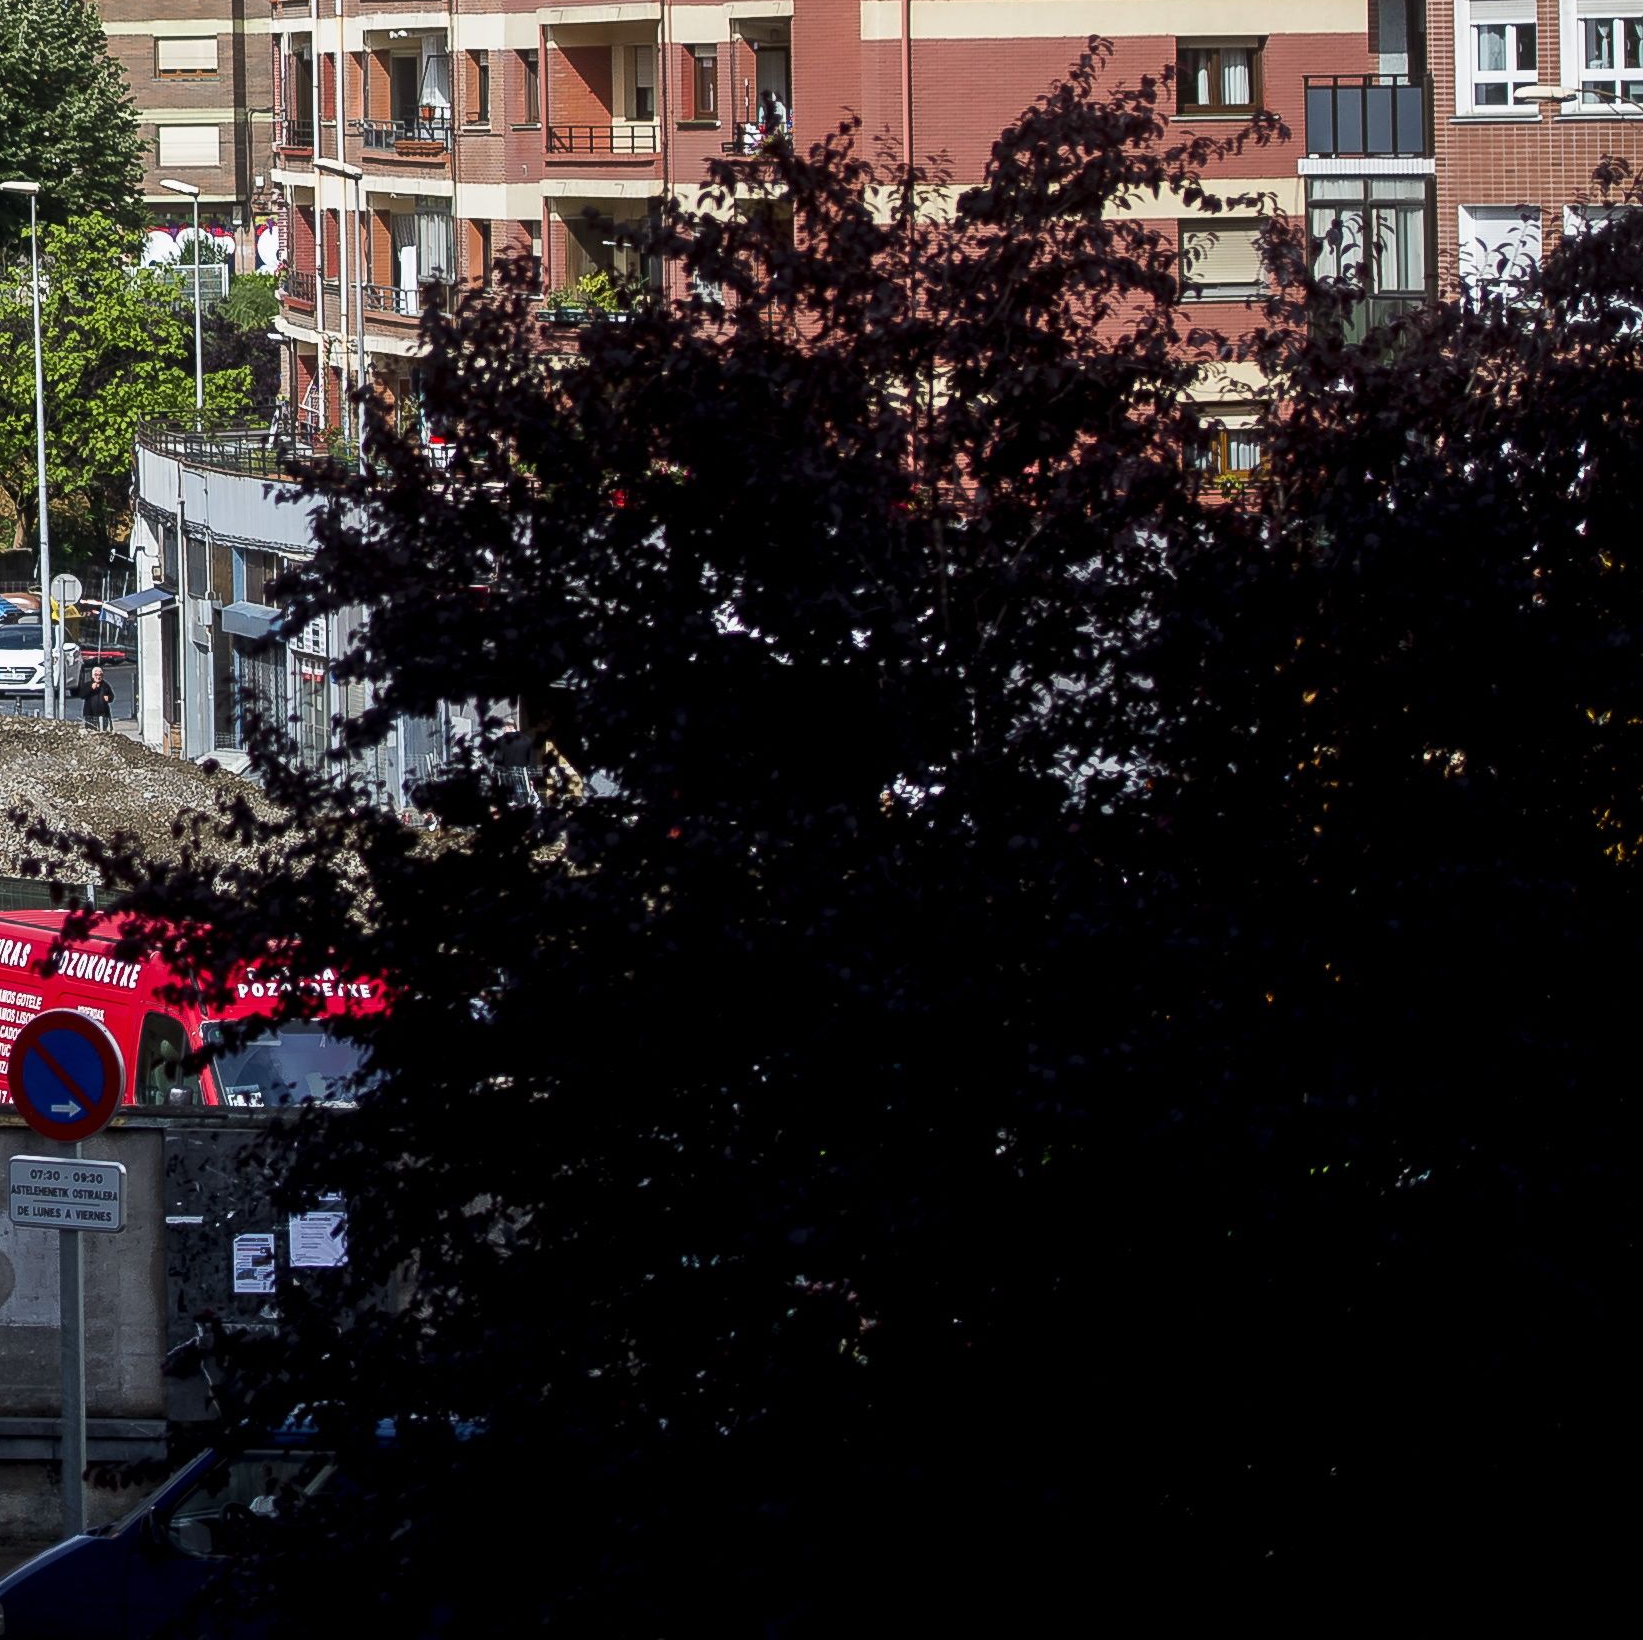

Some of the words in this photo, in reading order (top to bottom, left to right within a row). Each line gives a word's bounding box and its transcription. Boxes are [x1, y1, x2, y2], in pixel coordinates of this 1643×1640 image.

[52, 949, 142, 989] OZOKOETXE
[16, 992, 43, 1010] GOTELE
[30, 1169, 60, 1182] 07:30
[72, 1172, 103, 1184] 09:30
[17, 1205, 30, 1216] DE
[33, 1206, 62, 1219] LUNES
[64, 1209, 72, 1220] A
[75, 1210, 112, 1222] VIERNES
